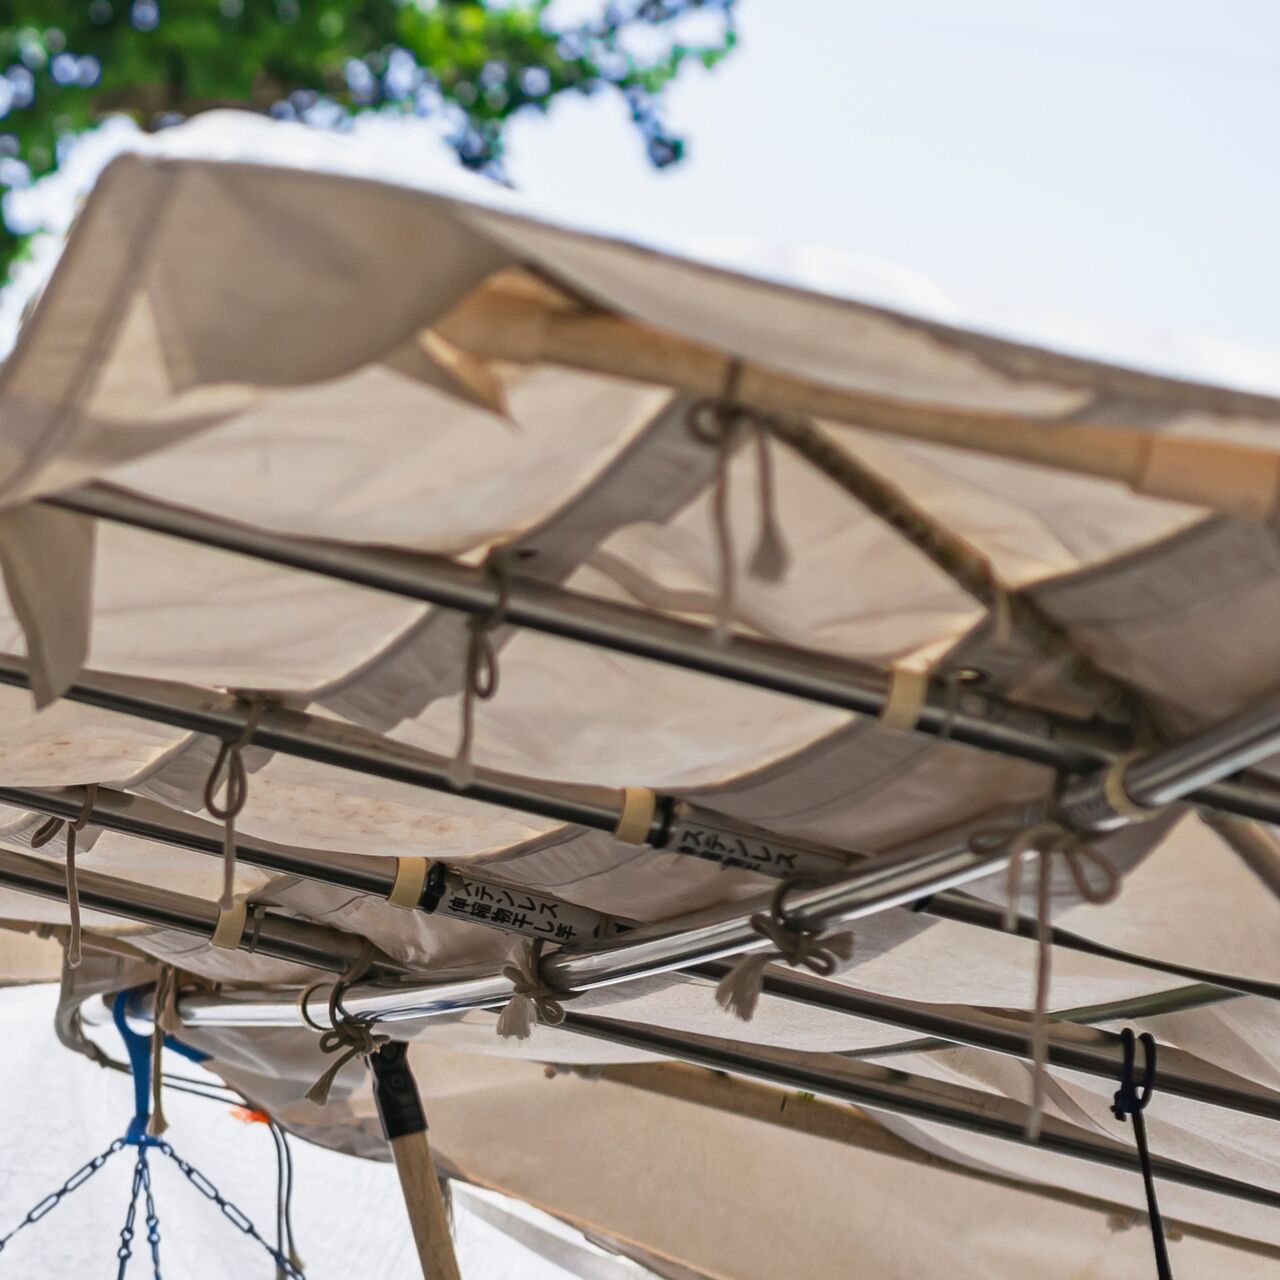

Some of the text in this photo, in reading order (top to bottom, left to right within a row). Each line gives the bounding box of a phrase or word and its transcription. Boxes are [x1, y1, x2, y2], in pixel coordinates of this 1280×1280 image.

[682, 829, 797, 869] ステンレス
